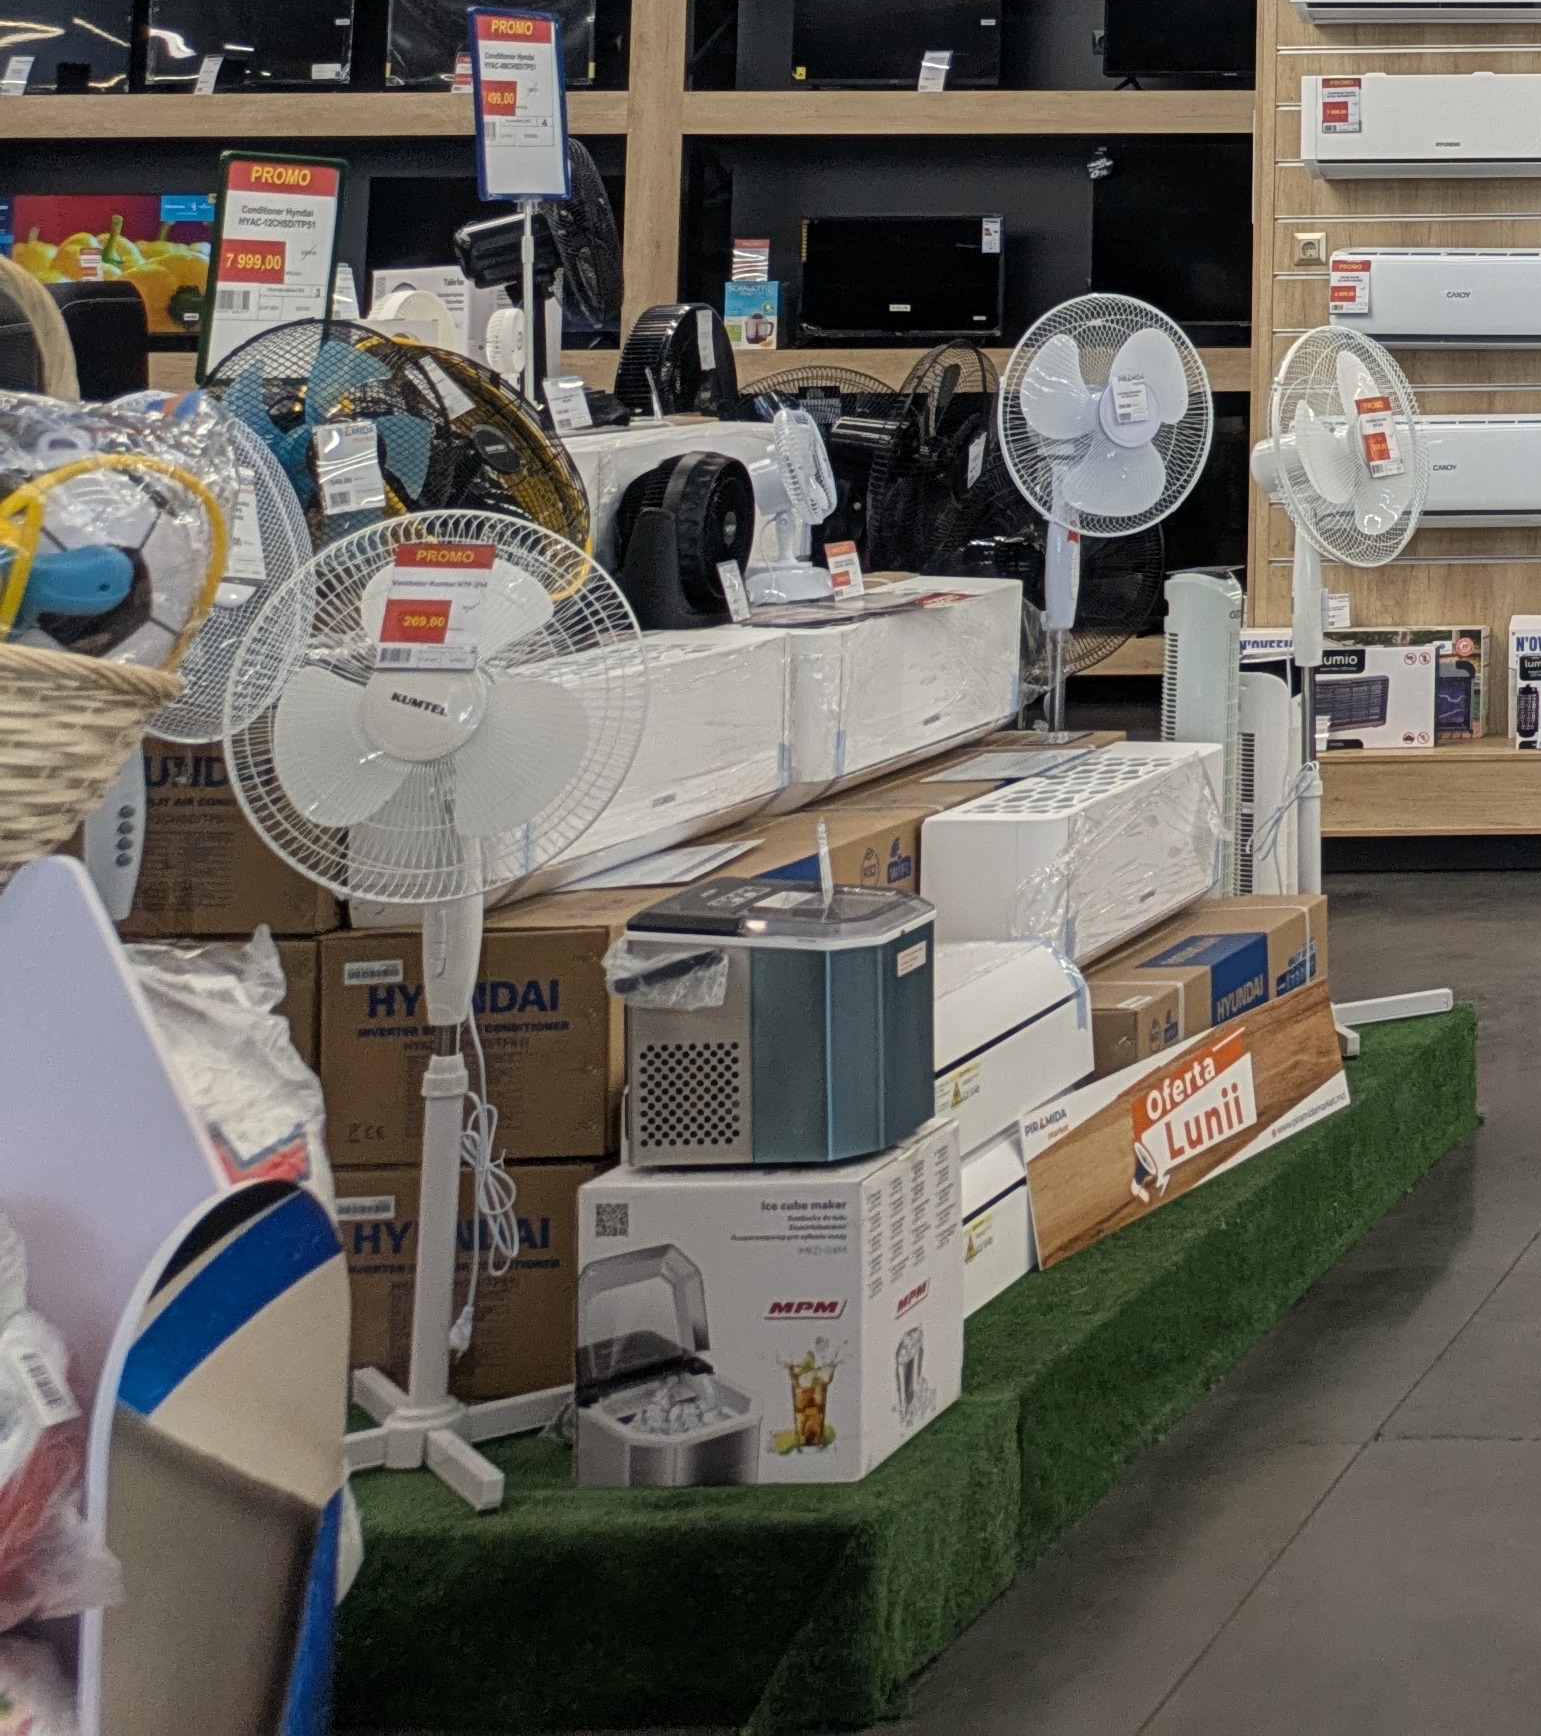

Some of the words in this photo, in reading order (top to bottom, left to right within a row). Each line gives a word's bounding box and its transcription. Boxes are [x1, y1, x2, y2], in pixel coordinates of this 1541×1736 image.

[491, 19, 534, 36] PROMO
[251, 166, 312, 187] PROMO
[241, 204, 285, 217] Conditioner
[225, 252, 233, 268] 7
[237, 254, 283, 272] 999,00
[1446, 291, 1471, 300] CANDY
[1432, 464, 1459, 472] CANDY
[416, 549, 475, 564] PROMO
[390, 691, 448, 717] KUMTEL
[368, 978, 562, 1019] HYNDAI
[1216, 972, 1264, 1024] HYUNDAI
[1145, 1054, 1217, 1122] Oferta
[1163, 1081, 1245, 1160] Lunii
[761, 1200, 778, 1211] Ice
[780, 1200, 808, 1211] cube
[811, 1200, 847, 1212] maker
[353, 1216, 550, 1256] HYNDAI
[769, 1300, 840, 1315] MPM
[896, 1280, 929, 1315] MPM
